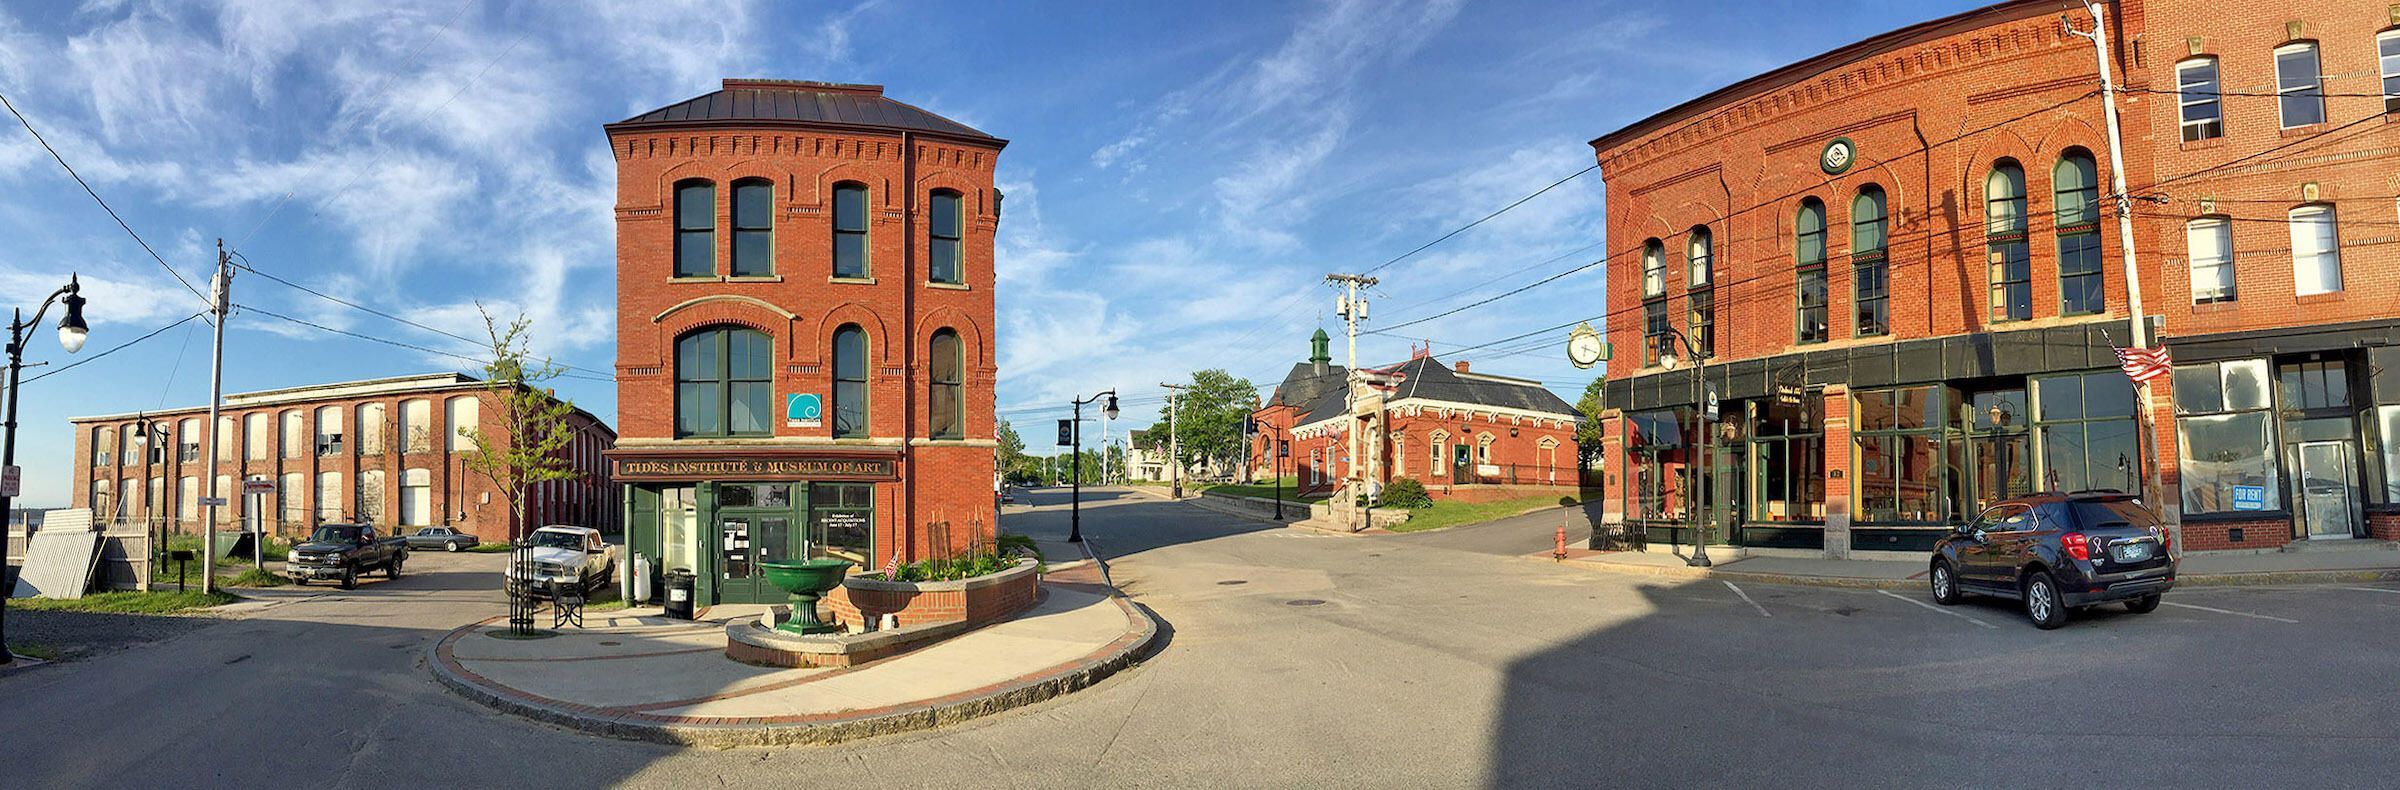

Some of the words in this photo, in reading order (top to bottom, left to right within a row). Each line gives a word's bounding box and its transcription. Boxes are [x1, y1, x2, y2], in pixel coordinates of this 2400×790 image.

[626, 462, 669, 473] TIDES
[673, 461, 748, 473] INSTITUTE
[752, 461, 763, 473] &
[767, 461, 828, 474] MUSEUM
[831, 461, 852, 473] OF
[854, 461, 881, 473] ART
[2235, 487, 2247, 500] FOR
[2247, 488, 2262, 501] RENT
